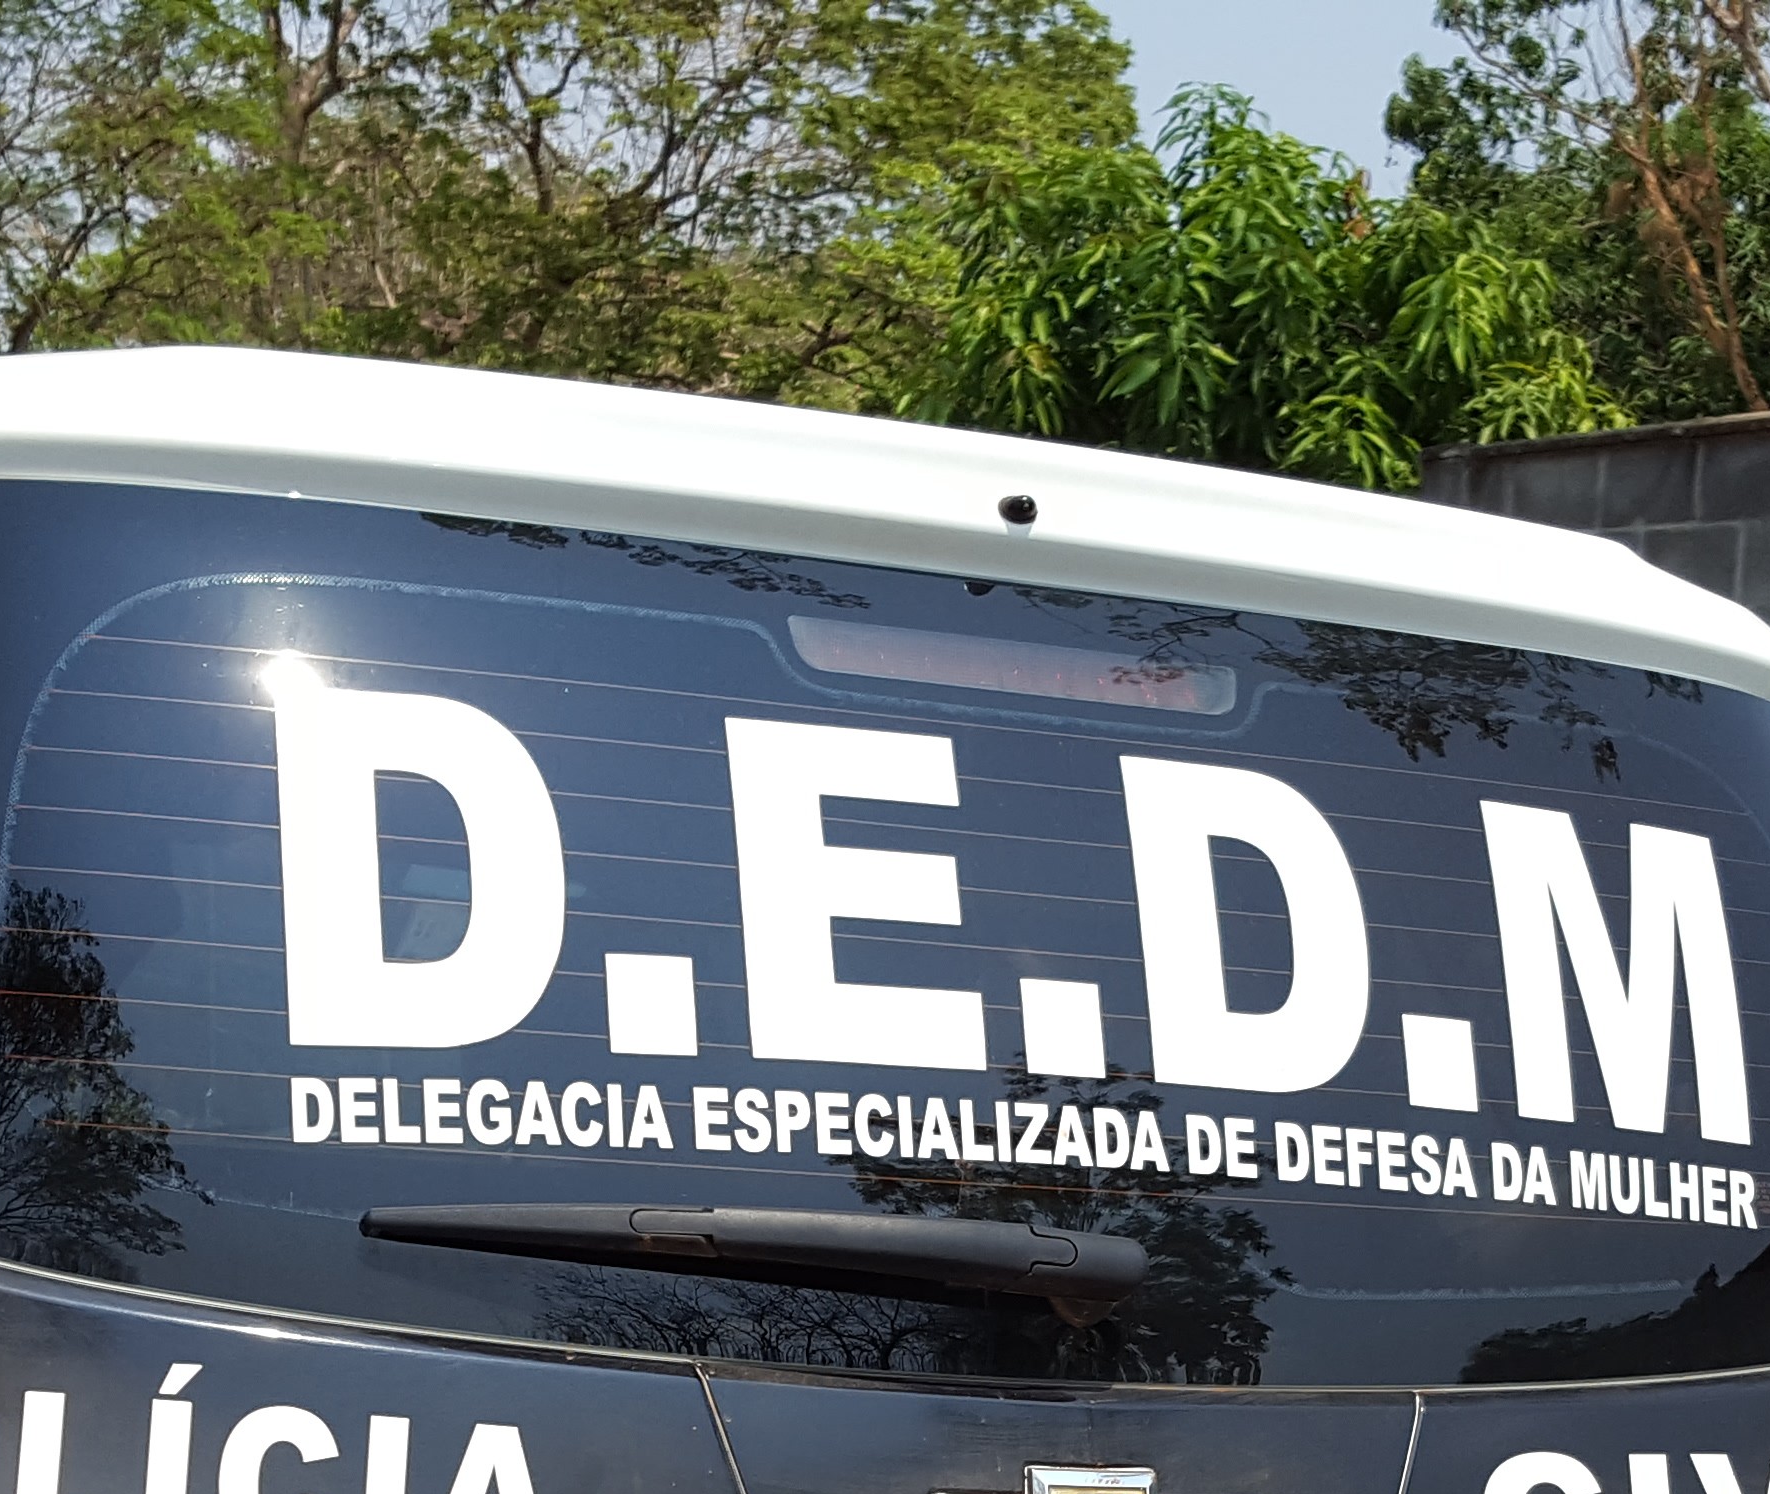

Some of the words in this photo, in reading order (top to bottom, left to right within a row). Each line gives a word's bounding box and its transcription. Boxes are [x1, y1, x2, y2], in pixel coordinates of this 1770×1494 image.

[274, 688, 1753, 1146] D.E.D.M
[289, 1076, 675, 1149] DELEGACIA
[691, 1086, 1171, 1173] ESPECIALIZADA
[1185, 1113, 1260, 1179] DE
[1274, 1120, 1478, 1198] DEFESA
[1490, 1141, 1557, 1206] DA
[1568, 1150, 1759, 1230] MULHER
